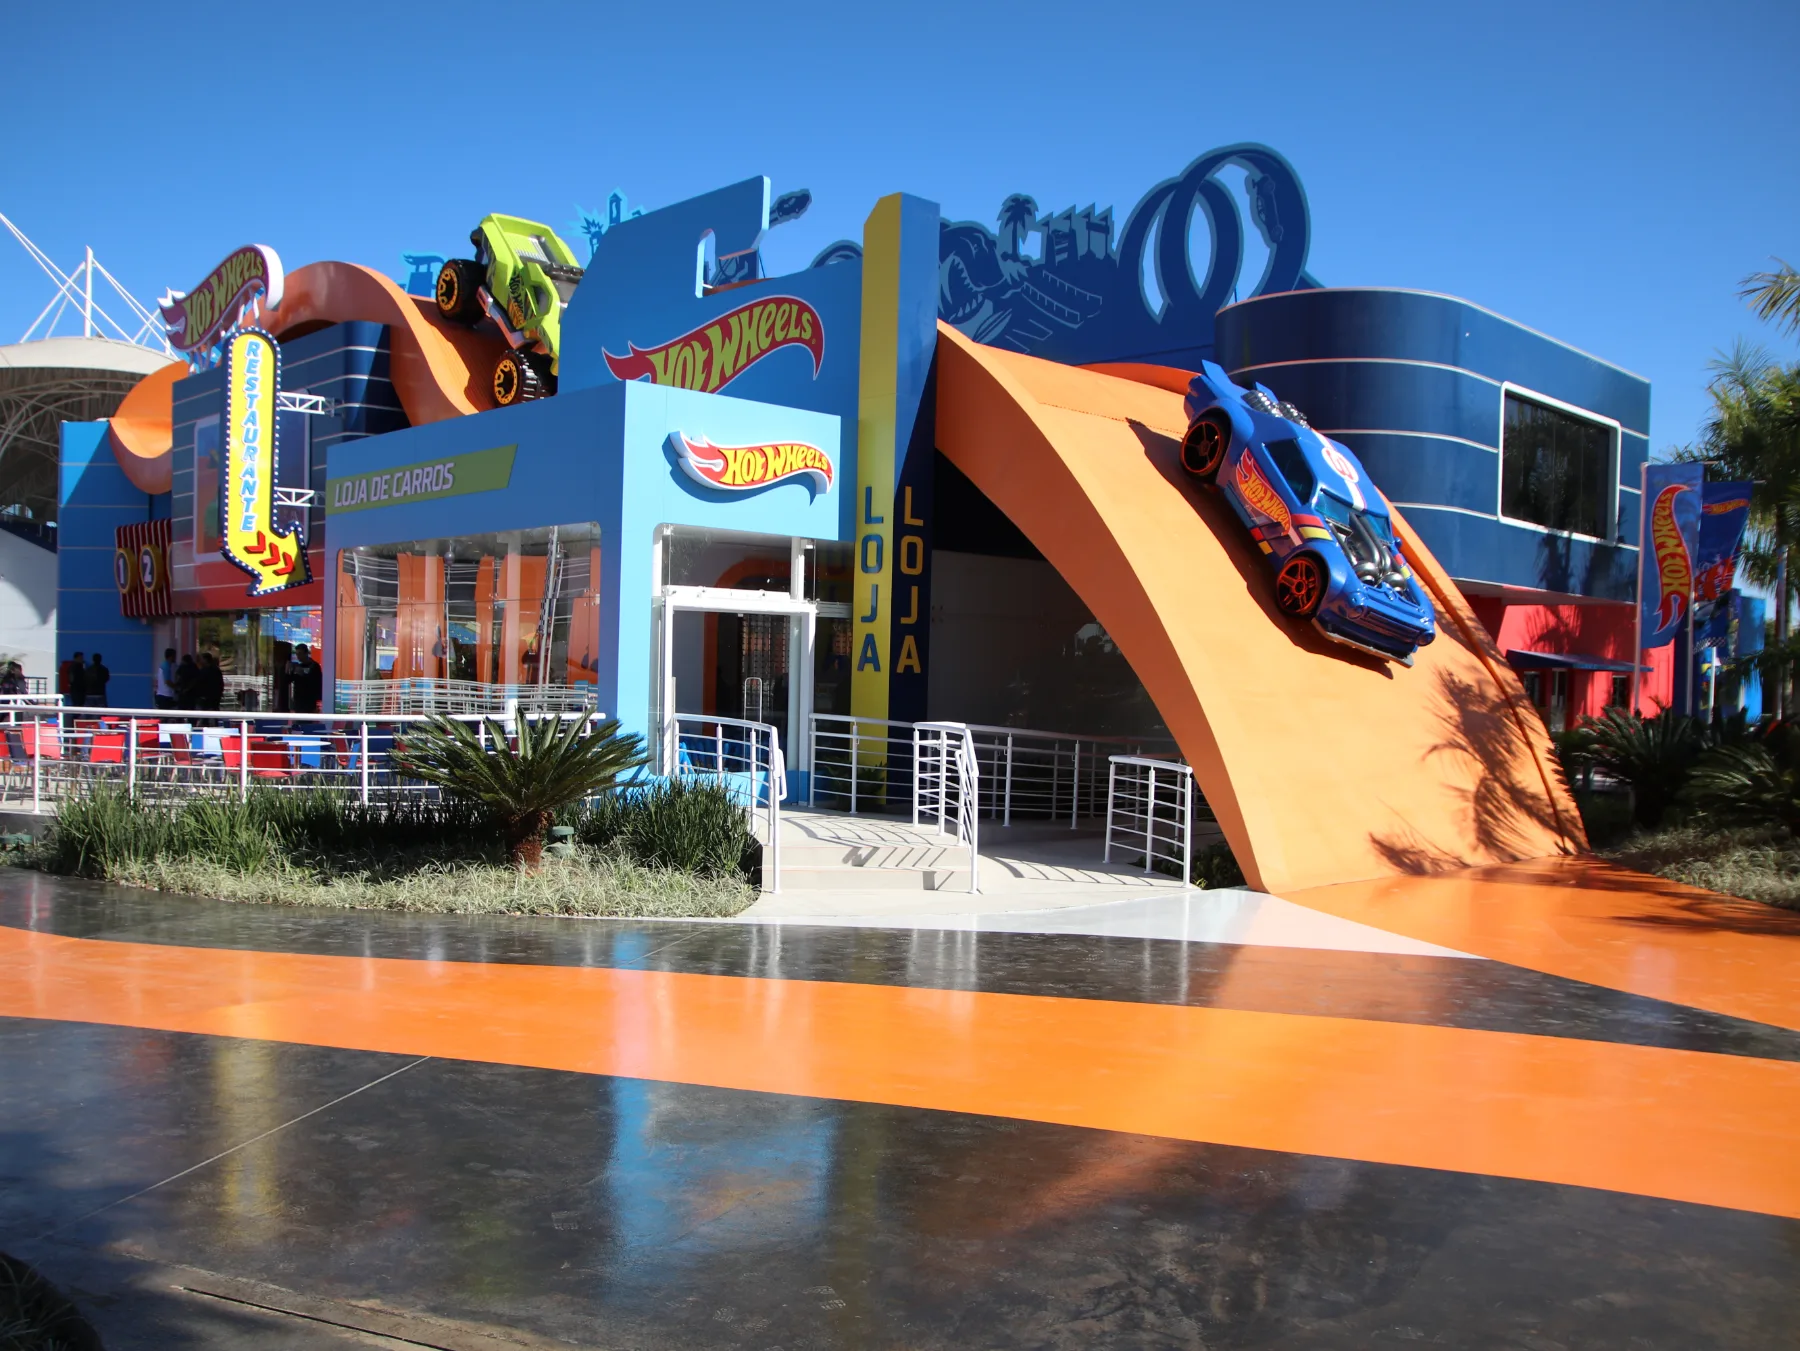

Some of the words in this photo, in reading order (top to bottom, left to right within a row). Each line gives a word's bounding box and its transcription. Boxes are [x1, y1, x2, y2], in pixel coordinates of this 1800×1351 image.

[240, 340, 262, 532] RESTAURANTE
[334, 479, 367, 507] LOJA
[370, 475, 390, 501] DE
[392, 463, 454, 497] CARROS
[118, 557, 125, 584] 1
[142, 554, 152, 583] 2
[856, 485, 884, 672] LOJA
[896, 485, 924, 674] LOJA
